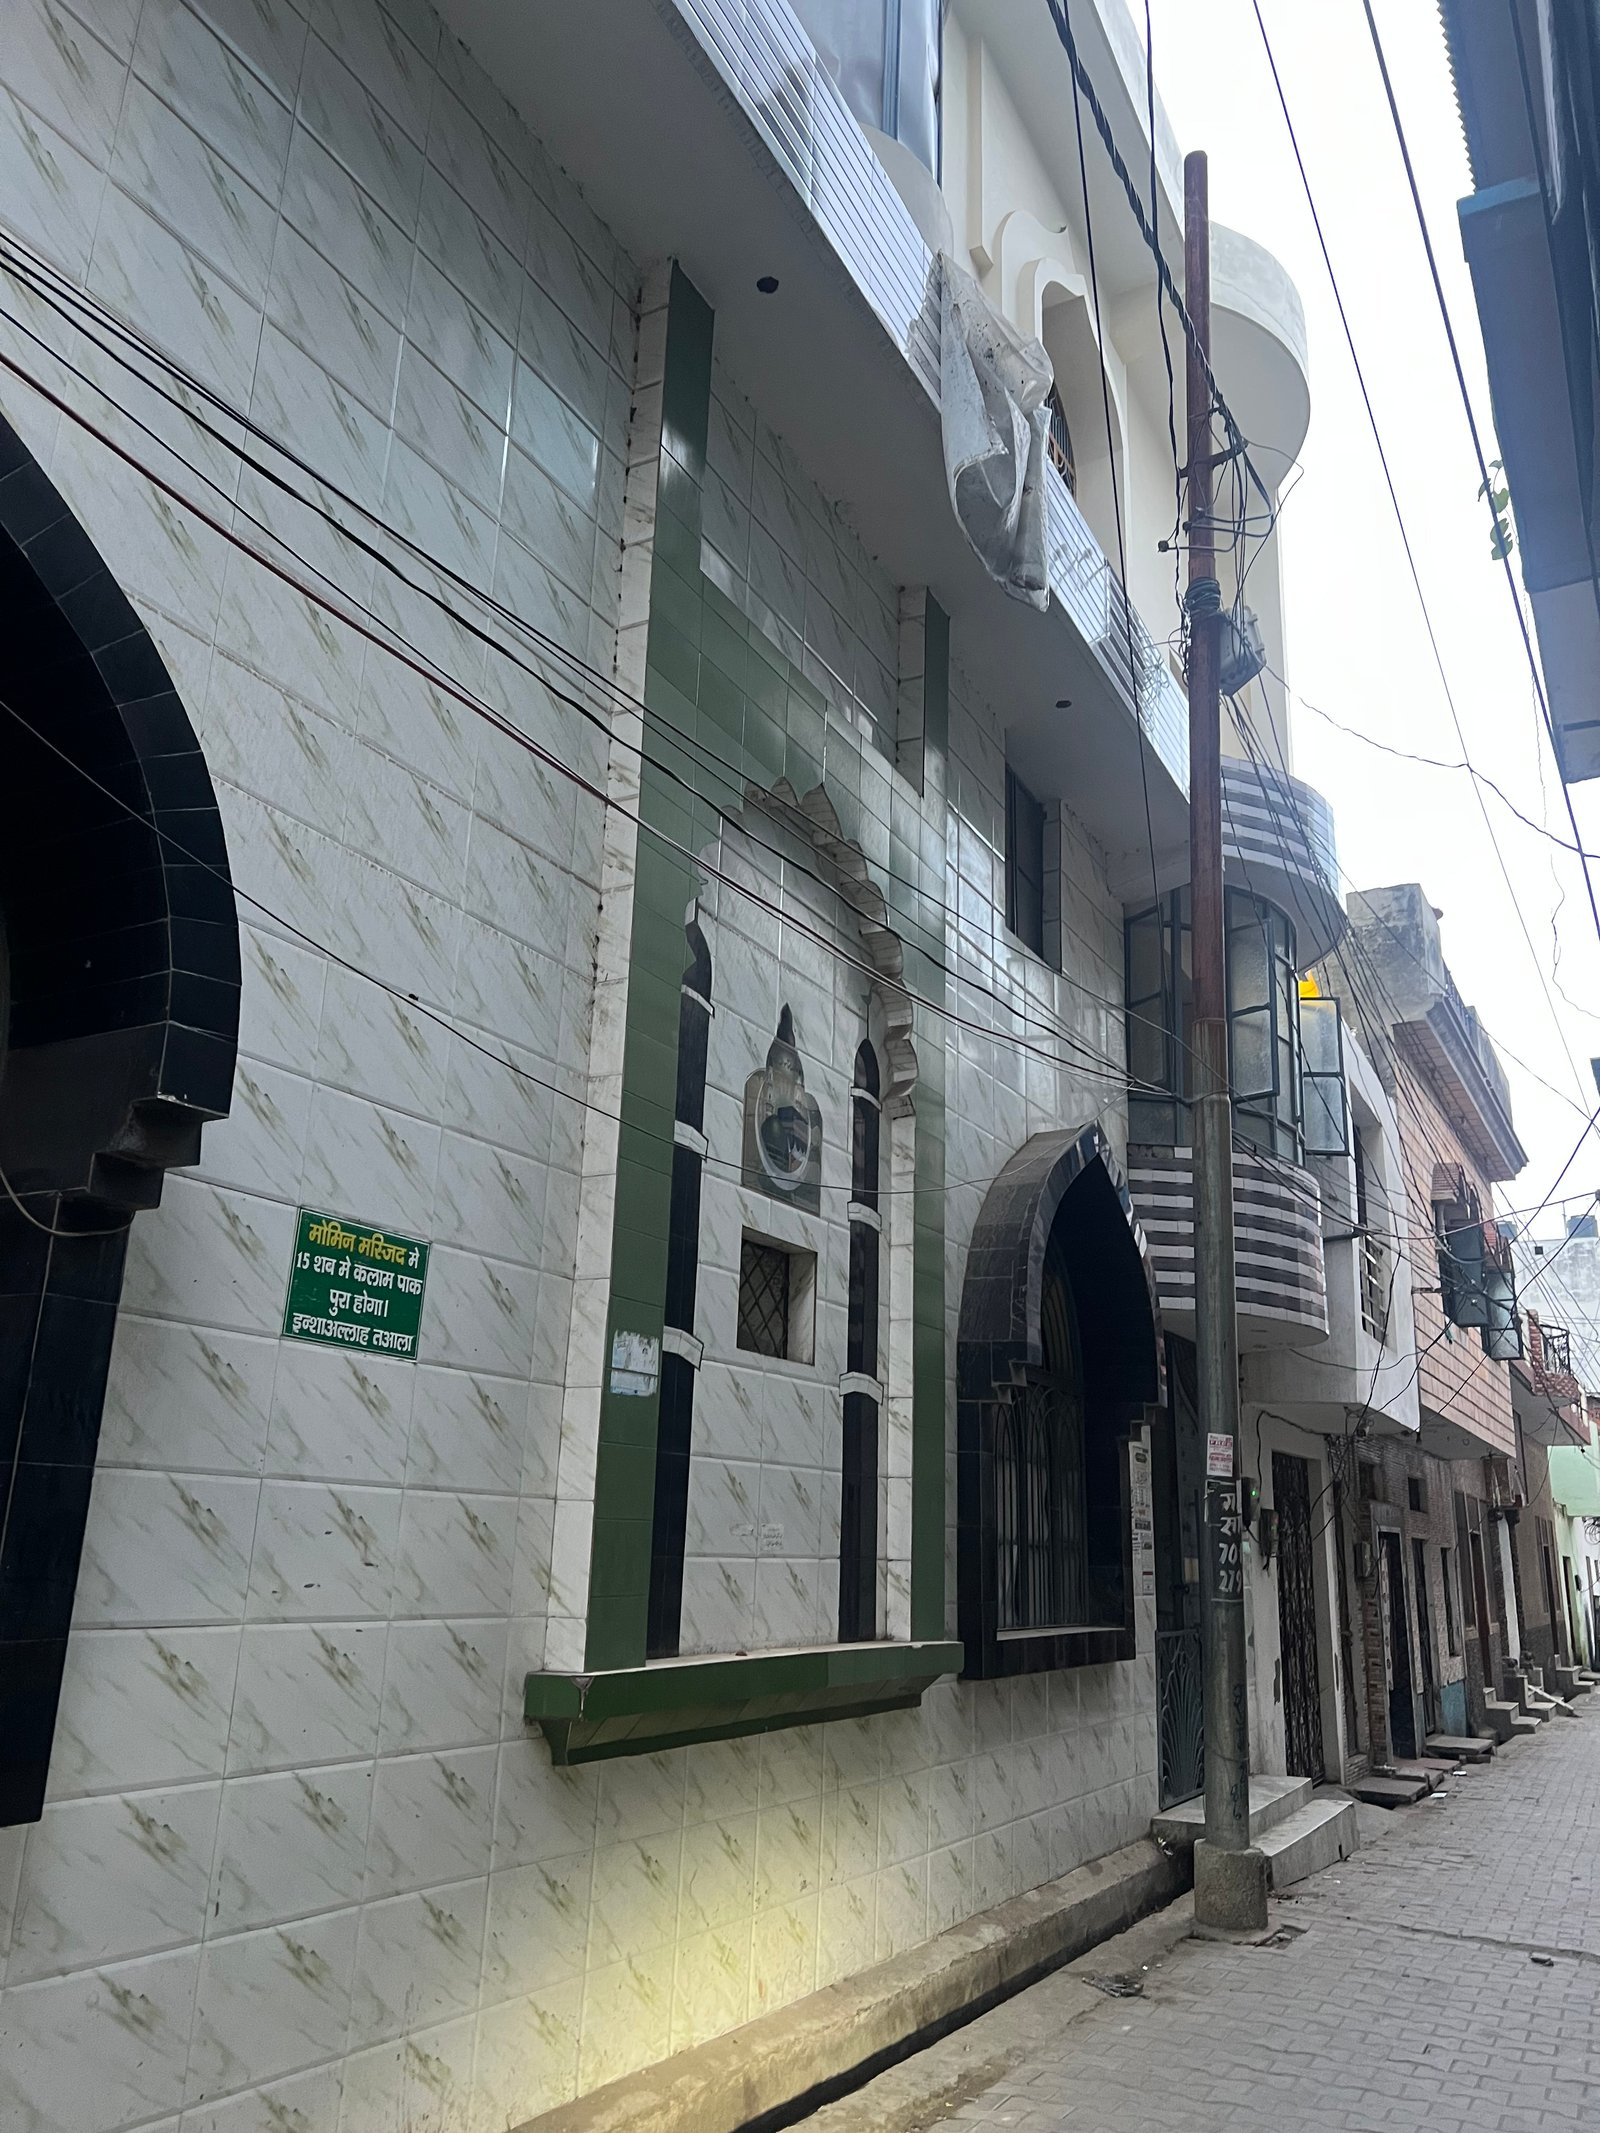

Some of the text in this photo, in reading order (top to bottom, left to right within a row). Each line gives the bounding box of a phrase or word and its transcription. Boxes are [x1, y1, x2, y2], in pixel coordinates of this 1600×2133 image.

[308, 1219, 356, 1252] मोमिन
[358, 1233, 407, 1265] मस्जिद
[296, 1251, 310, 1269] 15
[353, 1263, 394, 1289] कलाम
[397, 1274, 423, 1296] पाक
[329, 1288, 352, 1316] पुरा
